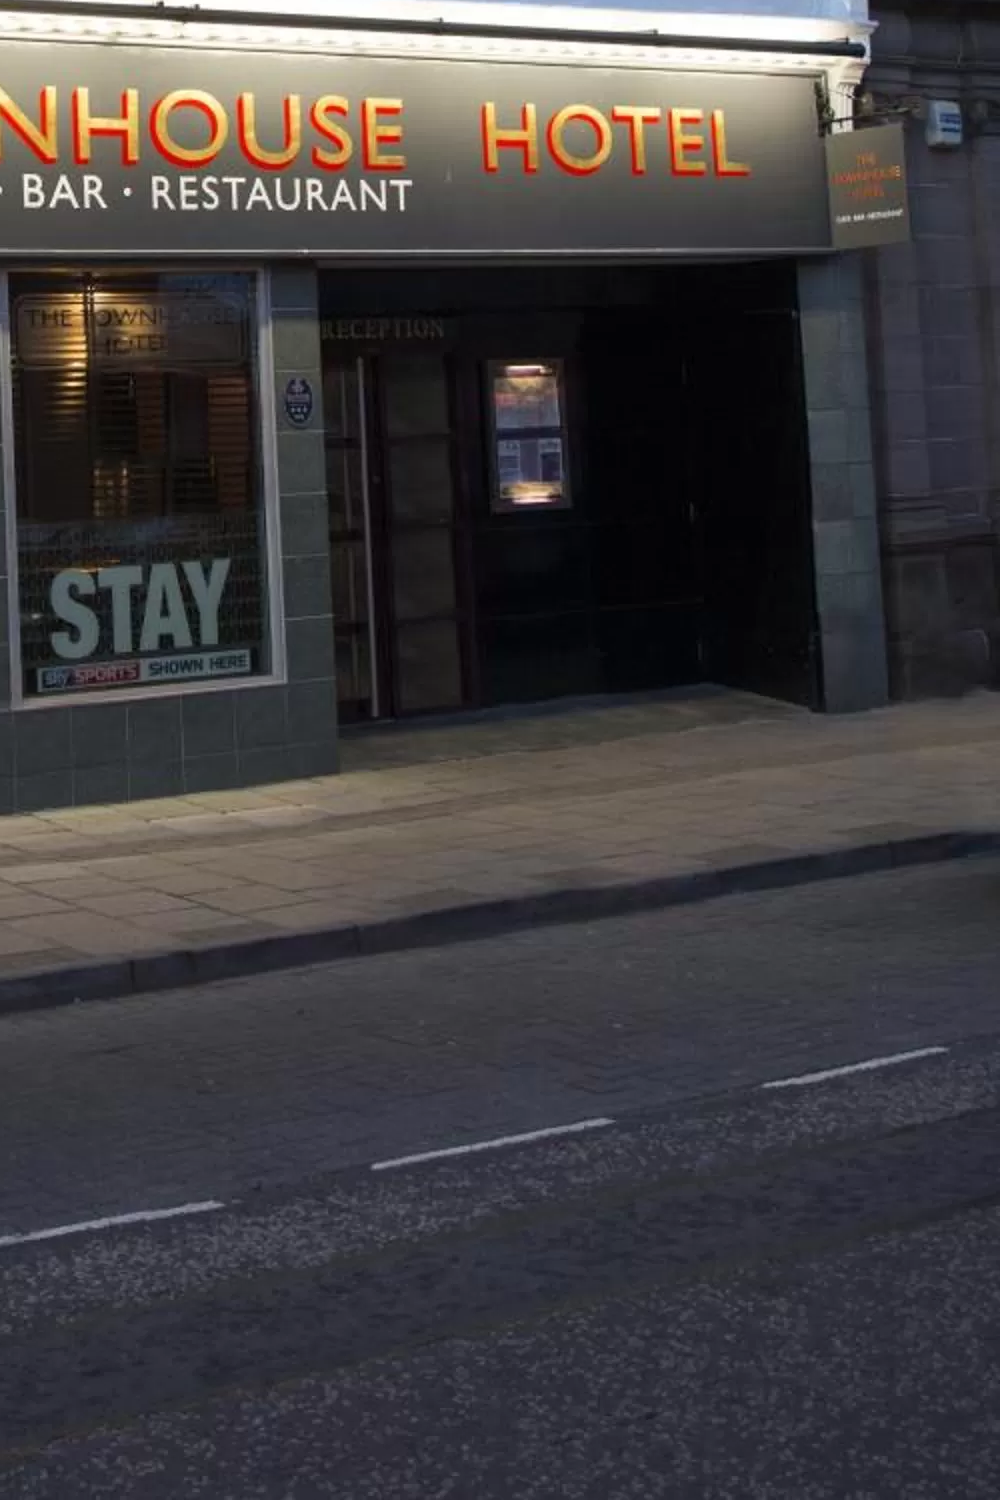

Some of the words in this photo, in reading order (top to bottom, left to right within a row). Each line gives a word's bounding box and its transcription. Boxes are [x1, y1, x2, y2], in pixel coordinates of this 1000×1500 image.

[480, 101, 753, 178] HOTEL
[21, 175, 105, 209] BAR
[150, 176, 413, 213] RESTAURANT
[50, 558, 231, 659] STAY
[148, 657, 205, 676] SHOWN
